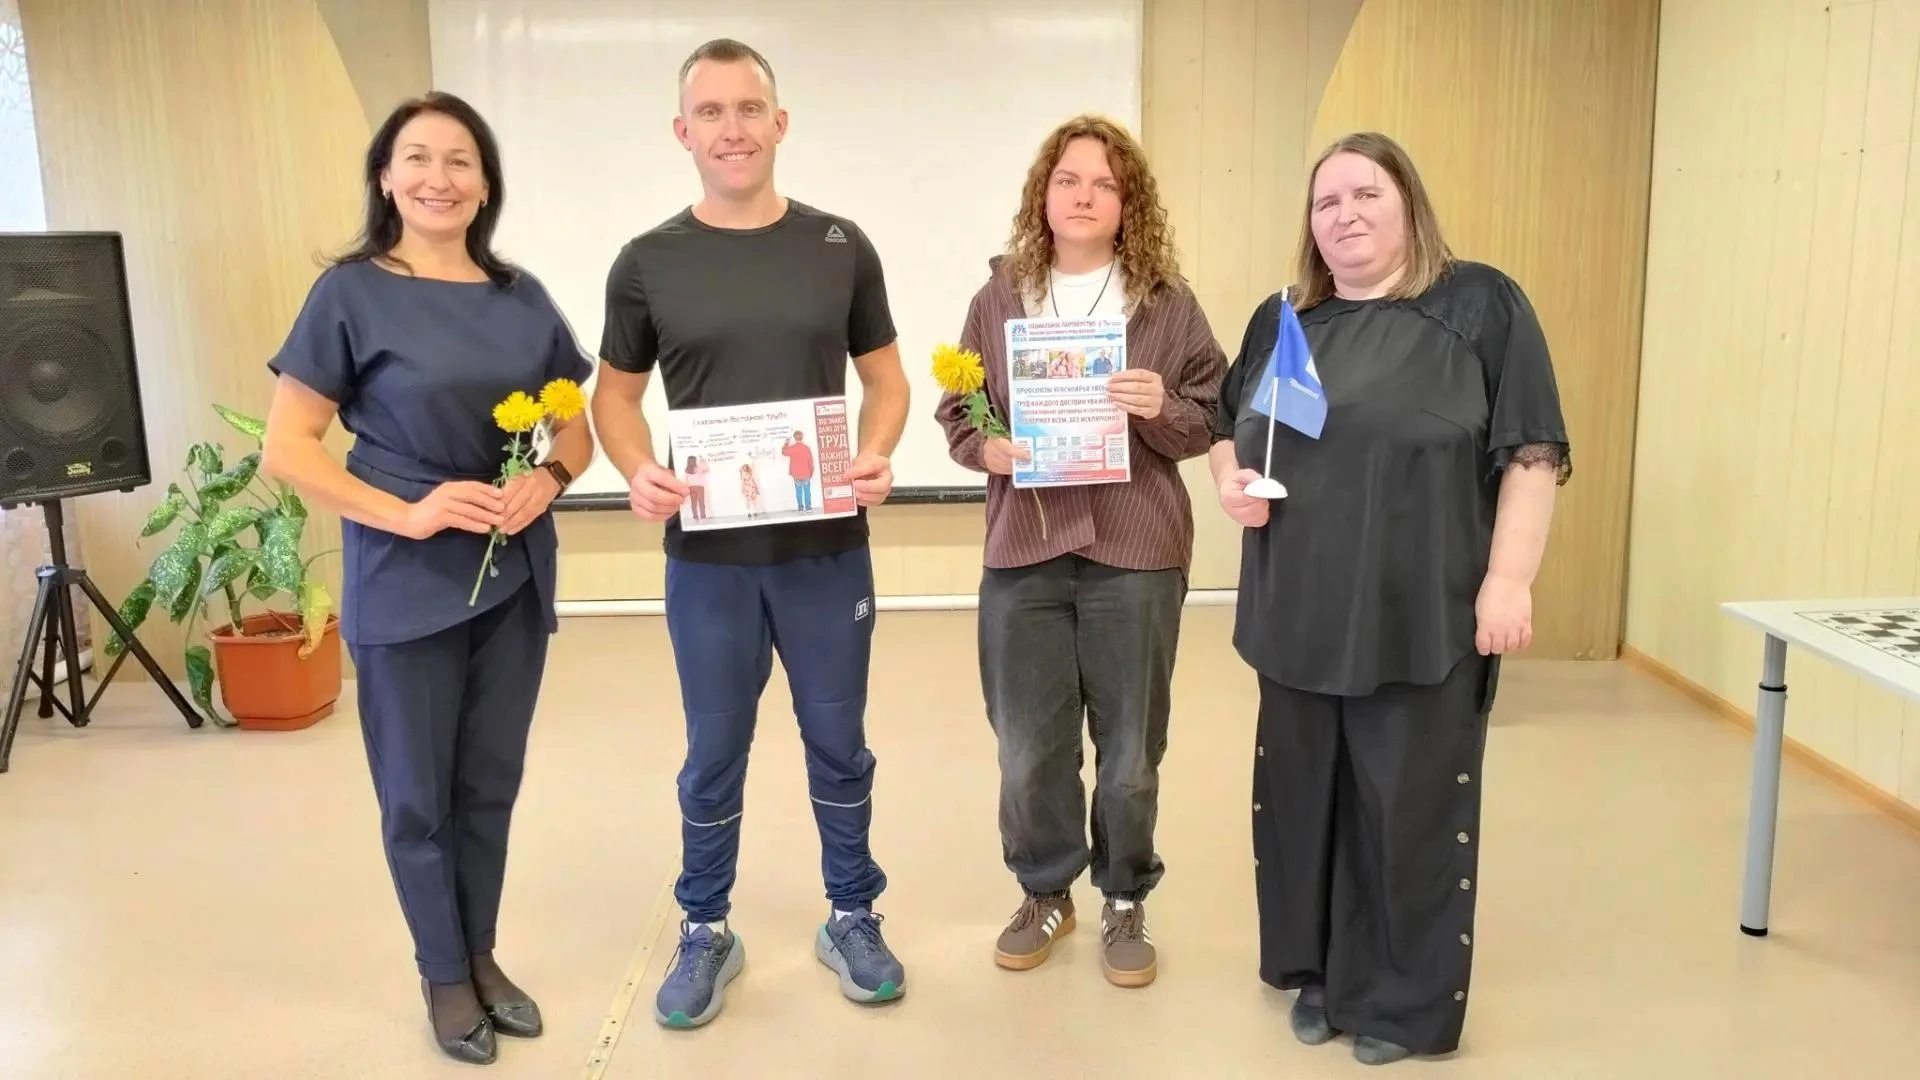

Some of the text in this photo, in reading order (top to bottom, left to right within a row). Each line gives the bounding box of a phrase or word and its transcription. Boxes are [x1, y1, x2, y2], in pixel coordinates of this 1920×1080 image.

[819, 433, 849, 449] ТРУД
[820, 450, 849, 461] ВАЖНЕЙ
[821, 460, 850, 474] ВСЕГО
